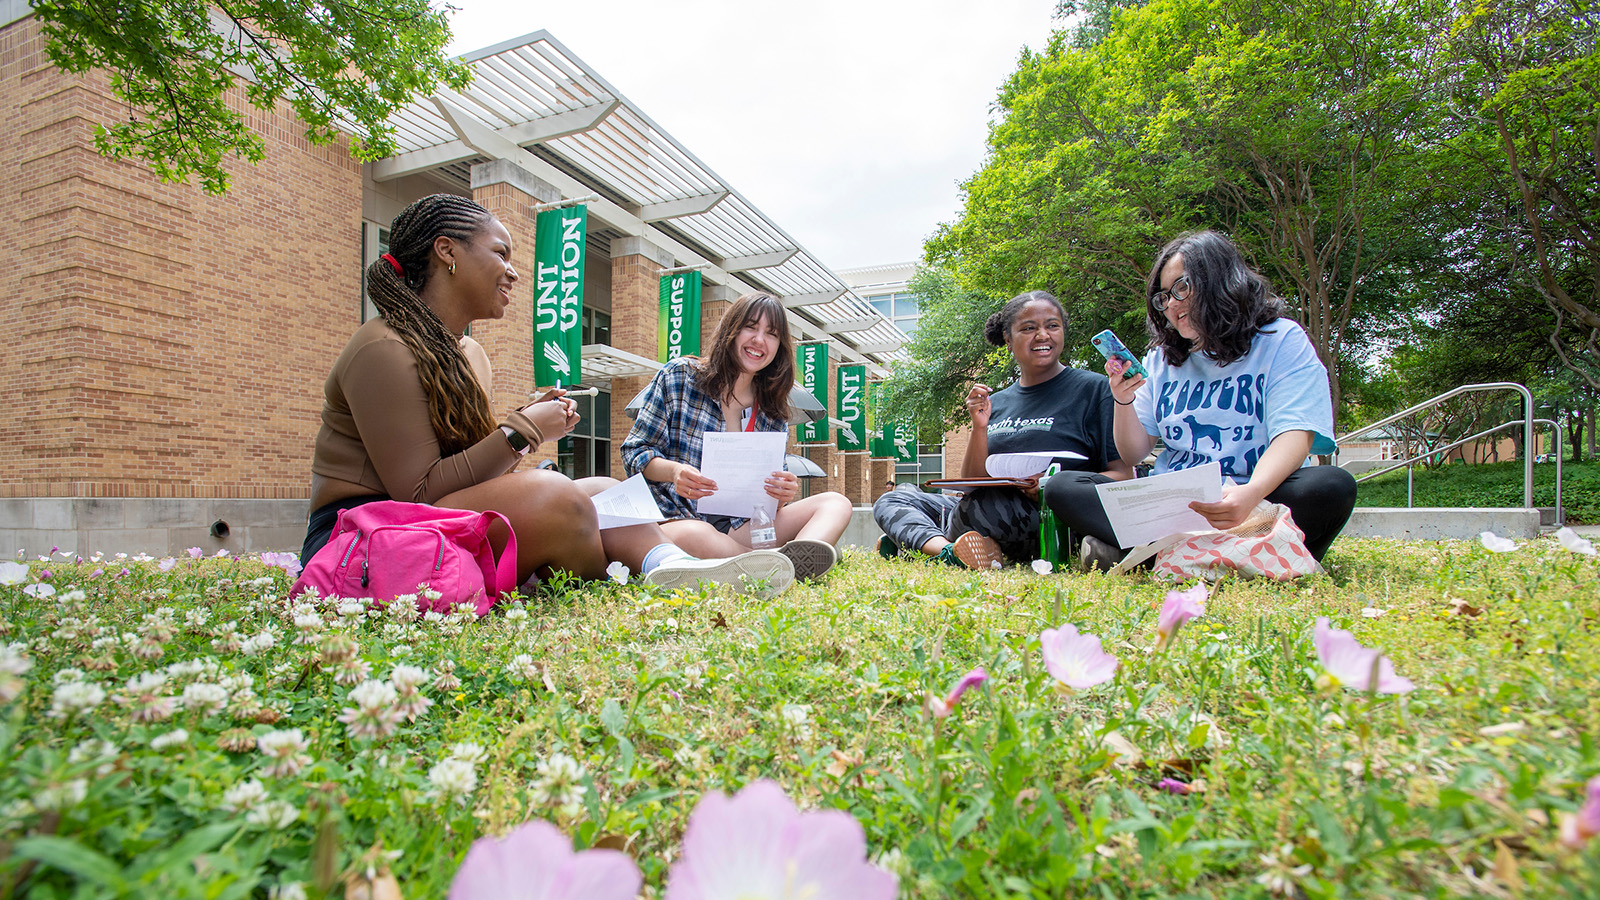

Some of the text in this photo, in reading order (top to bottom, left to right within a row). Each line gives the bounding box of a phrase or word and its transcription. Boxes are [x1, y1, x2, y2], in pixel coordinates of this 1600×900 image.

[537, 262, 558, 332] UNT
[560, 217, 582, 333] UNION
[669, 277, 685, 359] SUPPOR
[842, 371, 860, 422] UNT
[1014, 416, 1055, 427] texas
[1156, 373, 1265, 424] KOOPERS
[1165, 425, 1254, 441] 19 97
